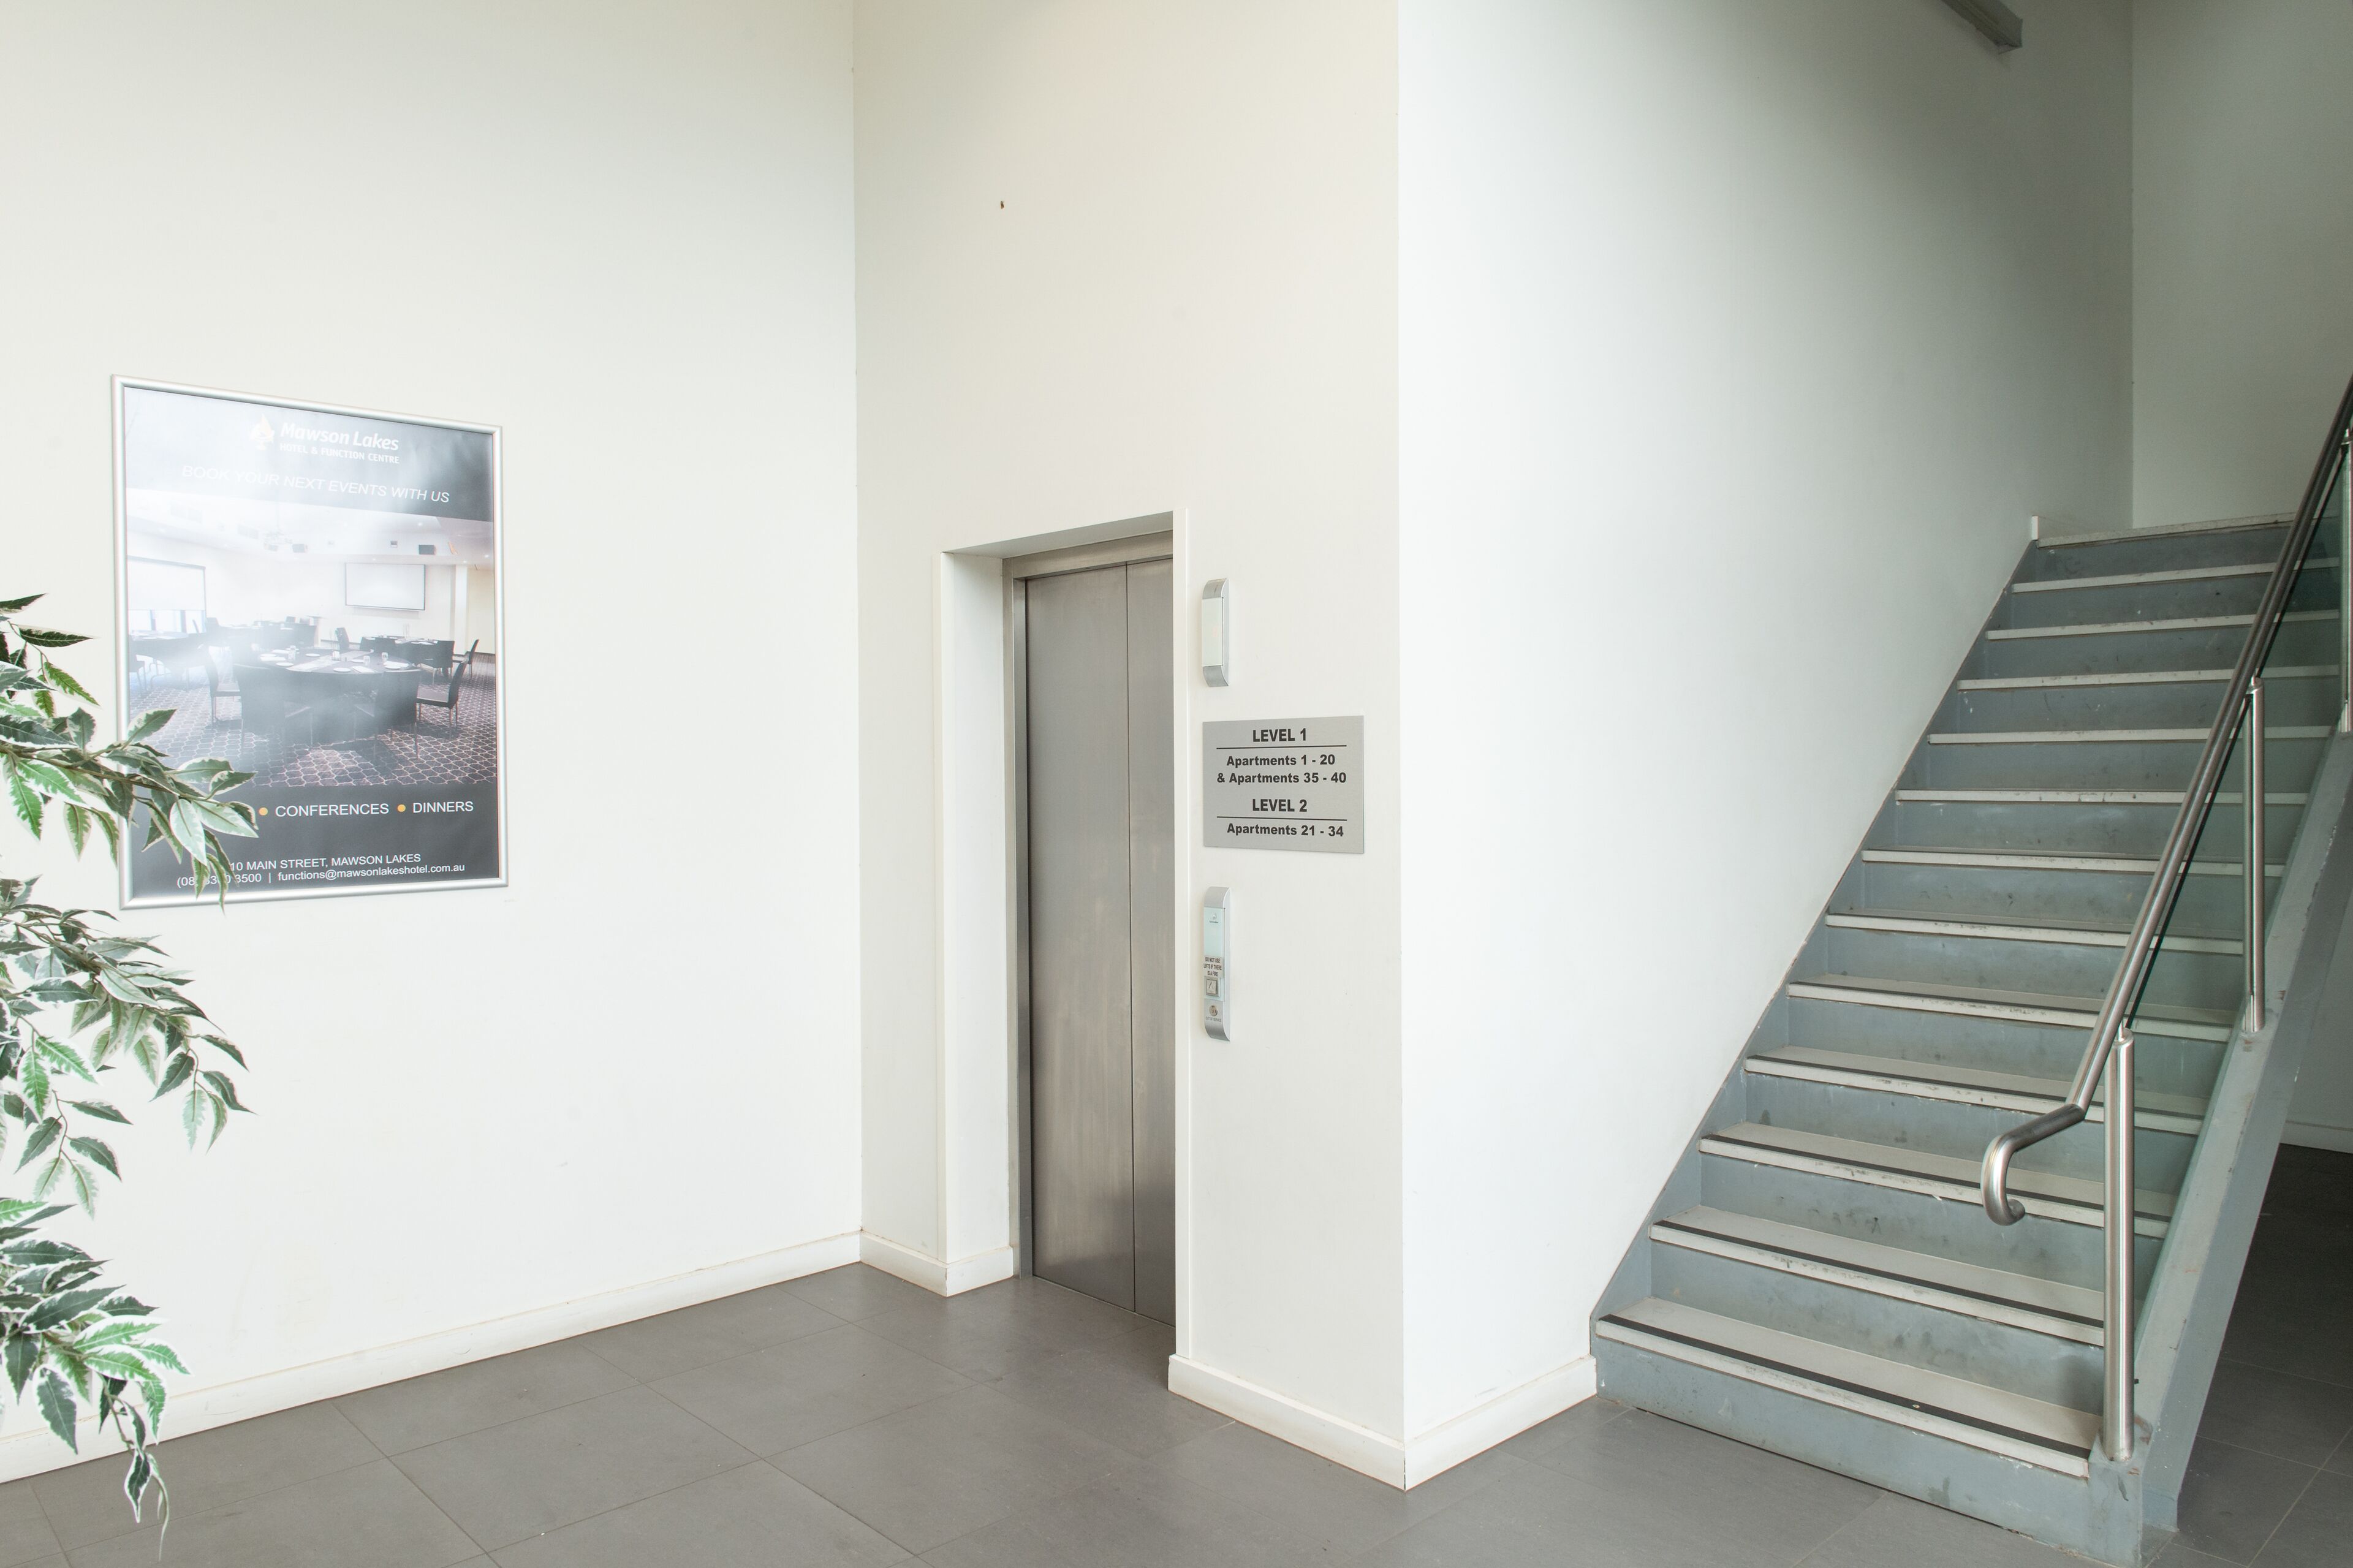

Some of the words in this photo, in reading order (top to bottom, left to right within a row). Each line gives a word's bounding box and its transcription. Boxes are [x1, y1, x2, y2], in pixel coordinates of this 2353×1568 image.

[281, 423, 349, 445] Mawson
[353, 431, 399, 450] Lakes
[279, 443, 308, 454] HOTEL
[320, 447, 365, 460] FUNCTION
[368, 453, 400, 464] CENTRE
[181, 465, 231, 481] BOOK
[235, 470, 280, 486] YOUR
[284, 475, 326, 490] NEXT
[328, 480, 387, 496] EVENTS
[391, 487, 428, 501] WITH
[430, 491, 450, 503] US
[1252, 729, 1295, 742] LEVEL
[1300, 728, 1306, 741] 1
[1226, 755, 1297, 768] Apartments
[1300, 755, 1307, 765] 1
[1319, 754, 1335, 765] 20
[1216, 773, 1226, 783] &
[1229, 773, 1300, 785] Apartments
[1303, 772, 1319, 783] 35
[1330, 772, 1347, 783] 40
[275, 803, 390, 817] CONFERENCES
[412, 801, 474, 813] DINNERS
[1252, 799, 1295, 812] LEVEL
[1299, 799, 1308, 812] 2
[1227, 823, 1297, 836] Apartments
[1301, 825, 1315, 836] 21
[1328, 826, 1344, 836] 34
[230, 862, 243, 871] 10
[246, 860, 277, 870] MAIN
[280, 858, 328, 869] STREET,
[331, 855, 384, 866] MAWSON
[386, 854, 422, 864] LAKES
[176, 876, 195, 888] (08
[278, 865, 466, 881] functions@mawsonlakeshotel.com.au
